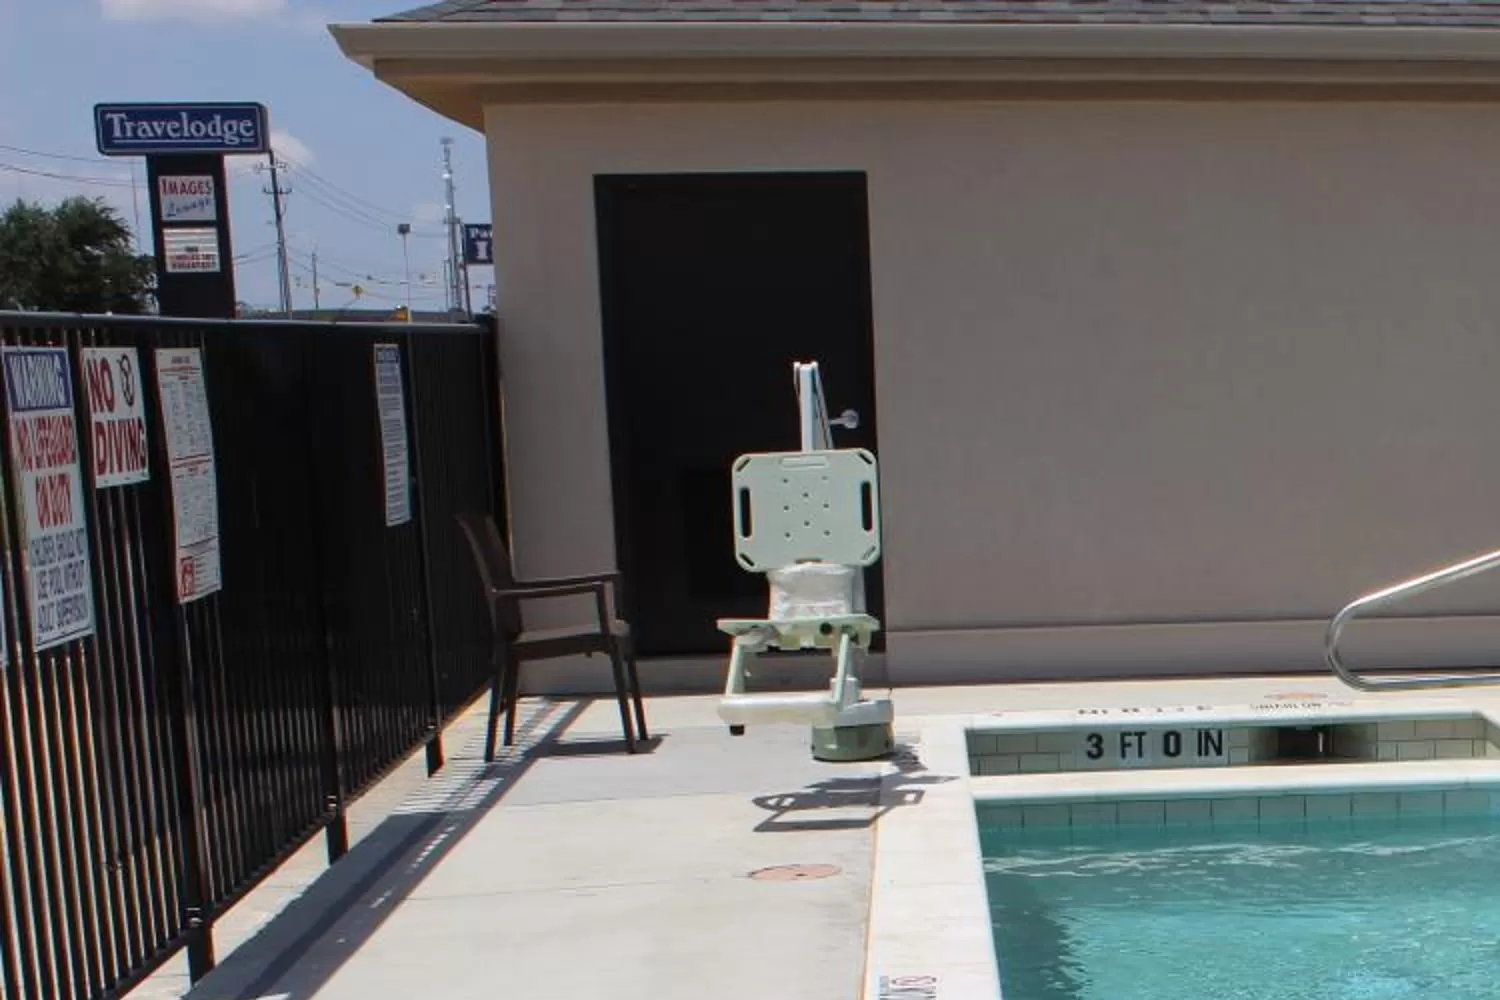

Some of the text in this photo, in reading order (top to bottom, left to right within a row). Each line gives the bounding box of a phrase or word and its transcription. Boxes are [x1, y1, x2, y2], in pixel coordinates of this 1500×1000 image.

[105, 112, 255, 145] Travelodge
[162, 178, 213, 196] IMAGES
[87, 357, 115, 413] NO
[95, 416, 147, 475] DIVING
[1086, 732, 1105, 760] 3
[1119, 731, 1148, 760] FT
[1197, 727, 1224, 757] IN
